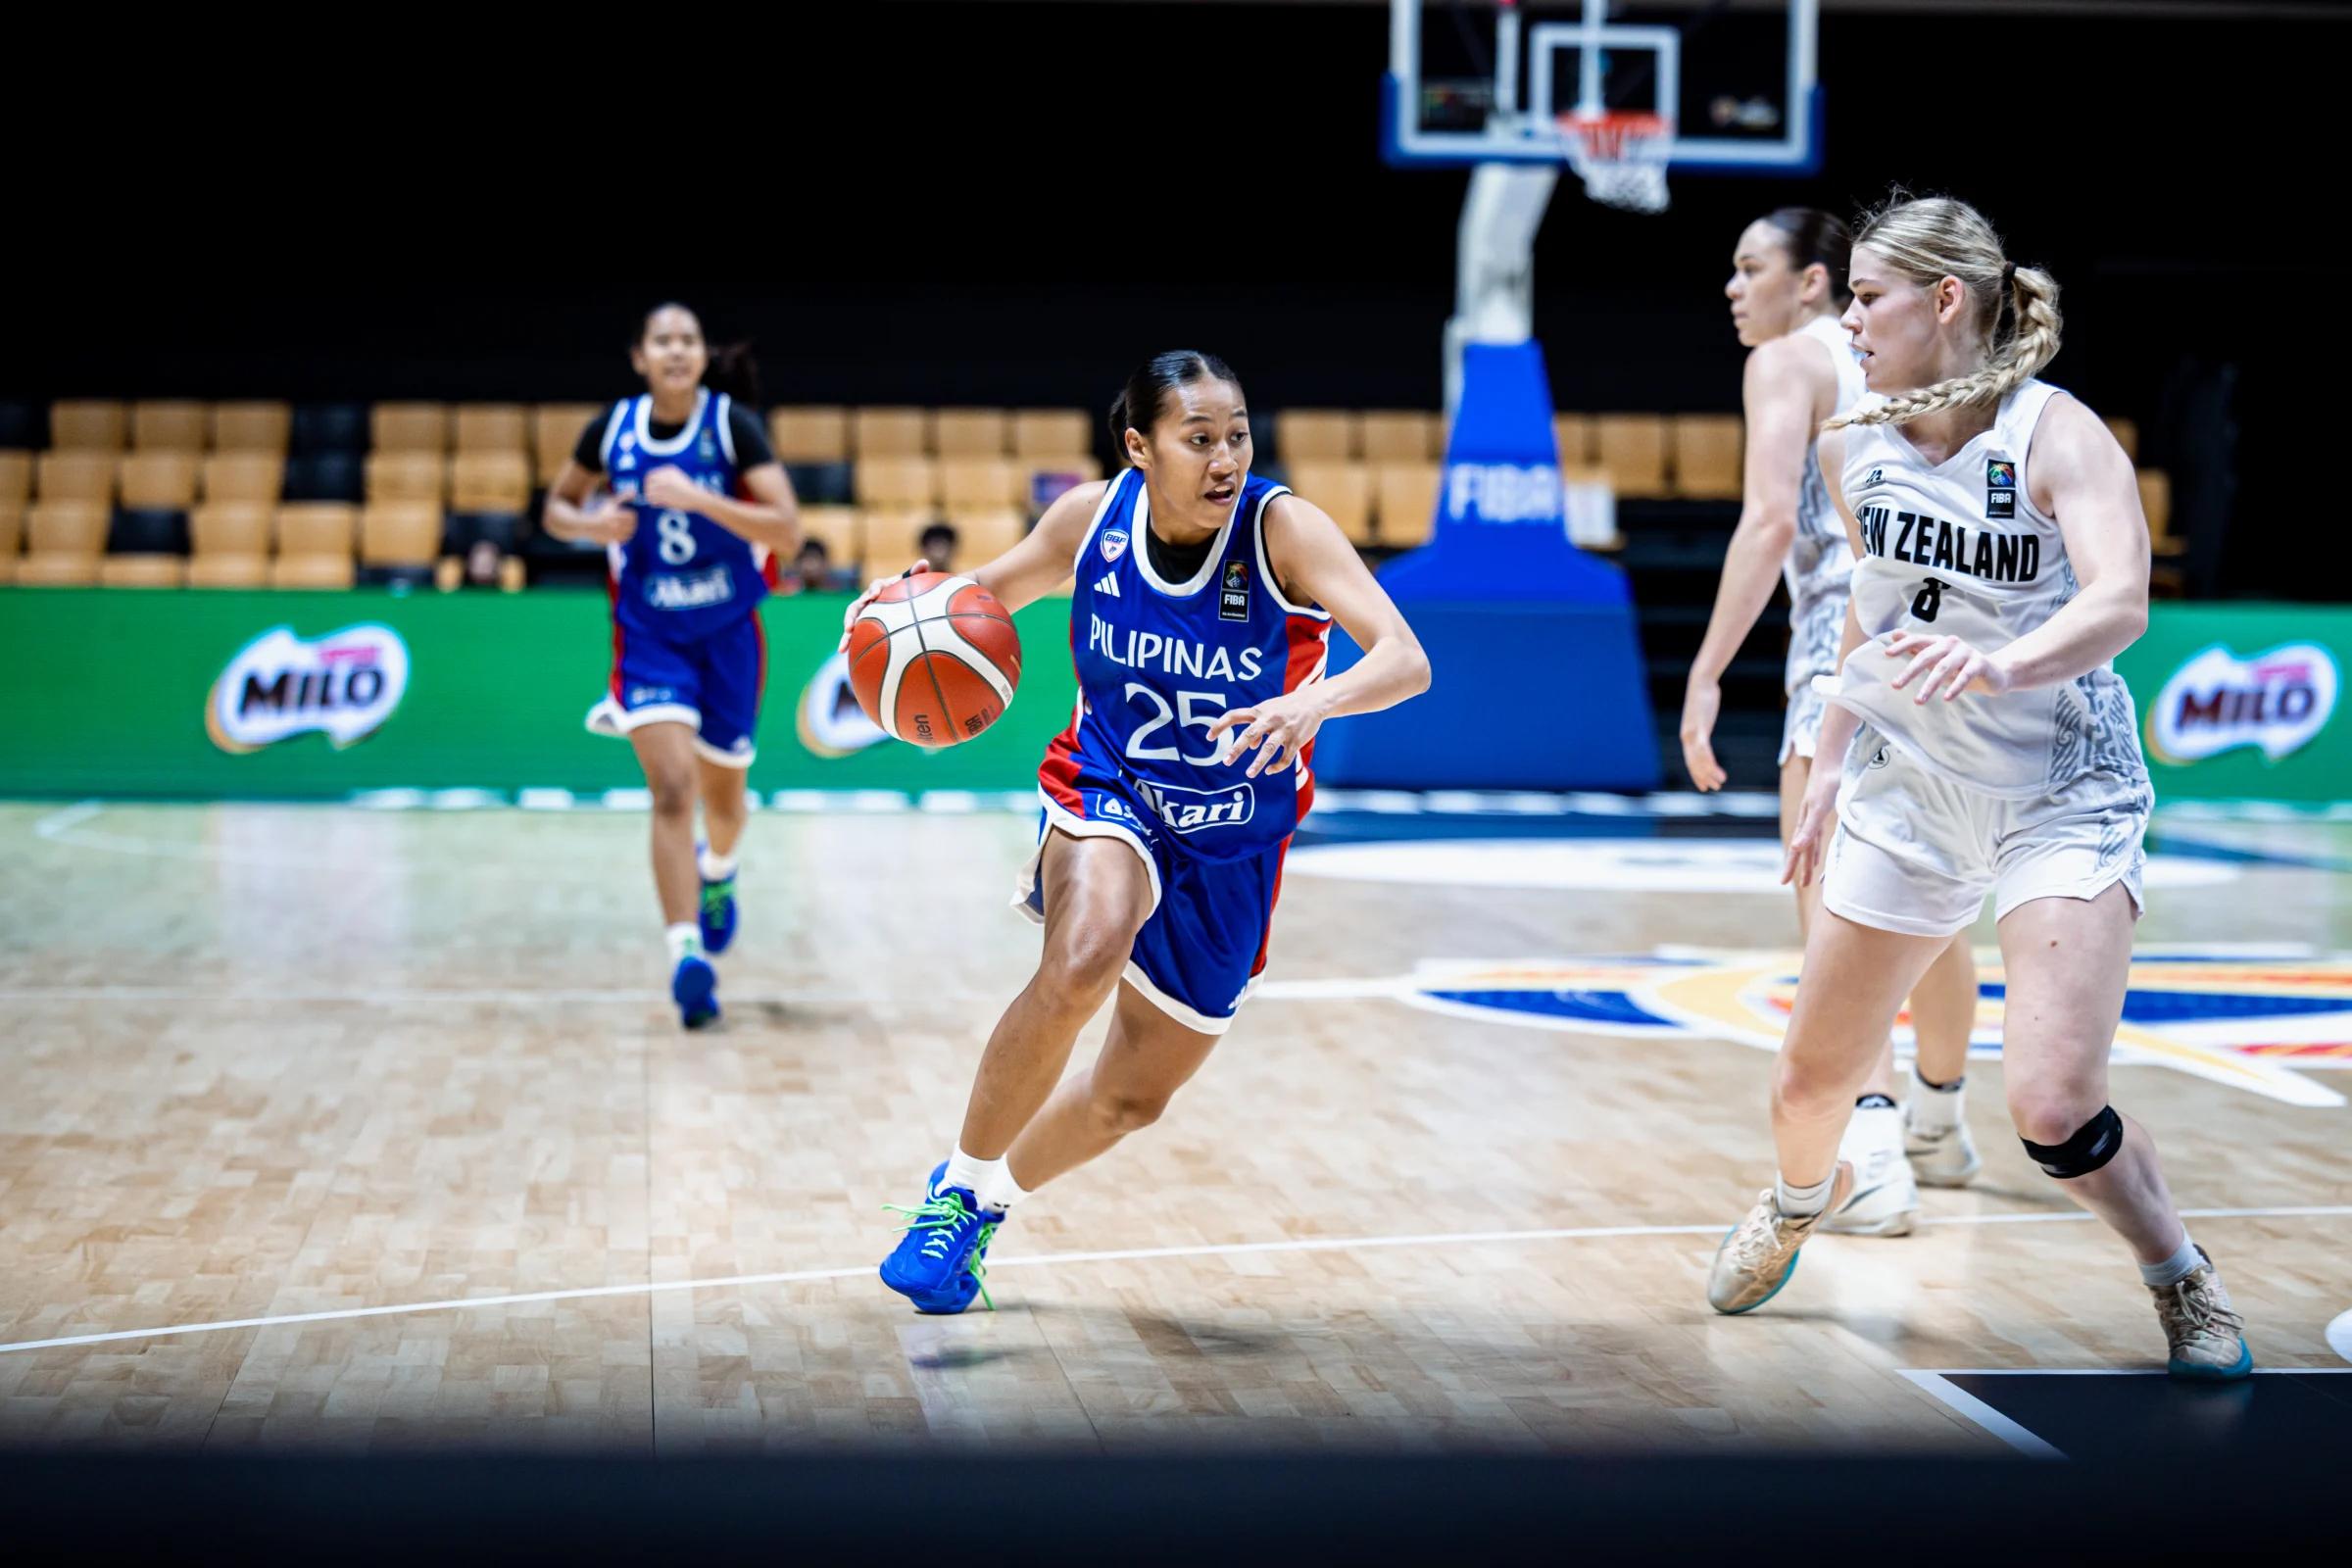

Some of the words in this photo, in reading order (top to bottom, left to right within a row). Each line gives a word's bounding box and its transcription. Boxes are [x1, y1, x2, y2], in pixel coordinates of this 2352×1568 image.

[1990, 493, 2012, 504] FIBA
[657, 511, 697, 565] 8
[1856, 507, 1889, 558] EW
[1894, 511, 2039, 583] ZEALAND
[1224, 594, 1246, 607] FIBA
[1089, 613, 1263, 683] PILIPINAS
[238, 668, 384, 717] MILO
[2175, 683, 2316, 734] MILO
[1124, 682, 1238, 766] 25
